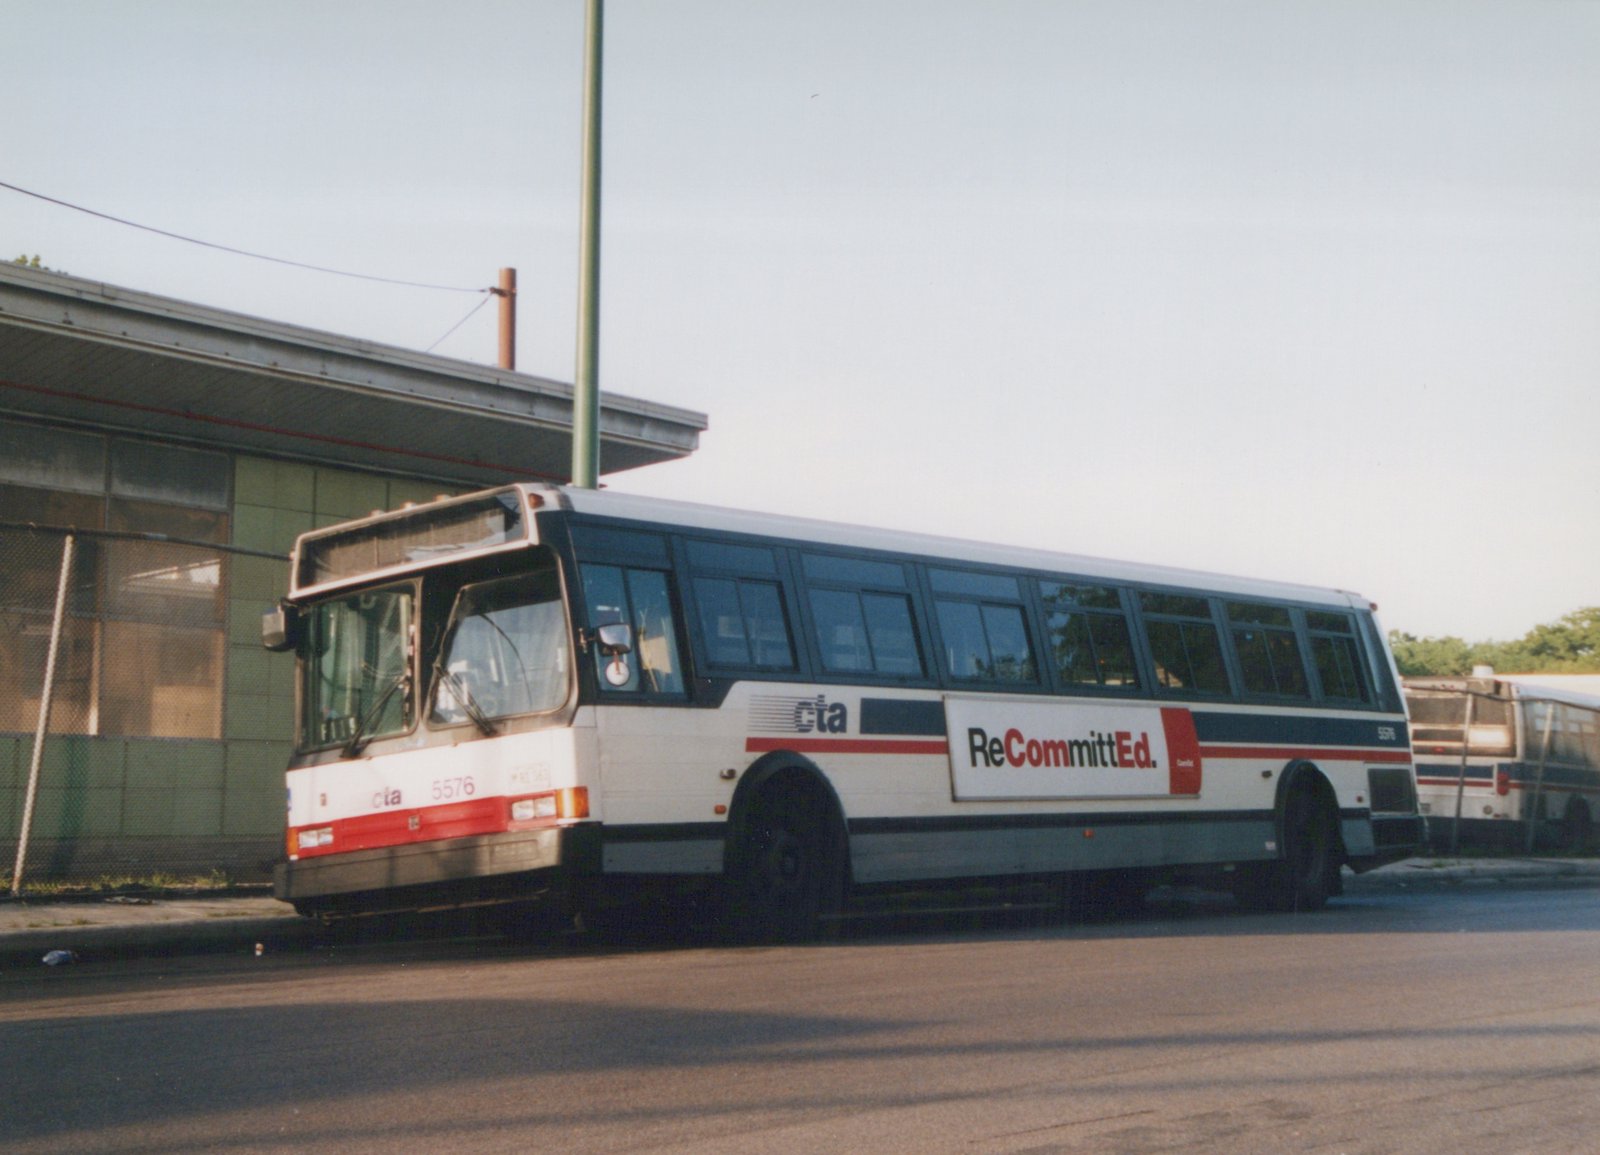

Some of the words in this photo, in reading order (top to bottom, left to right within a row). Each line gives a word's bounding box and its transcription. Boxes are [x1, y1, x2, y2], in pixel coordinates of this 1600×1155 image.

[794, 694, 847, 733] cta
[968, 727, 1157, 768] ReCommittEd.
[432, 776, 475, 800] 5576
